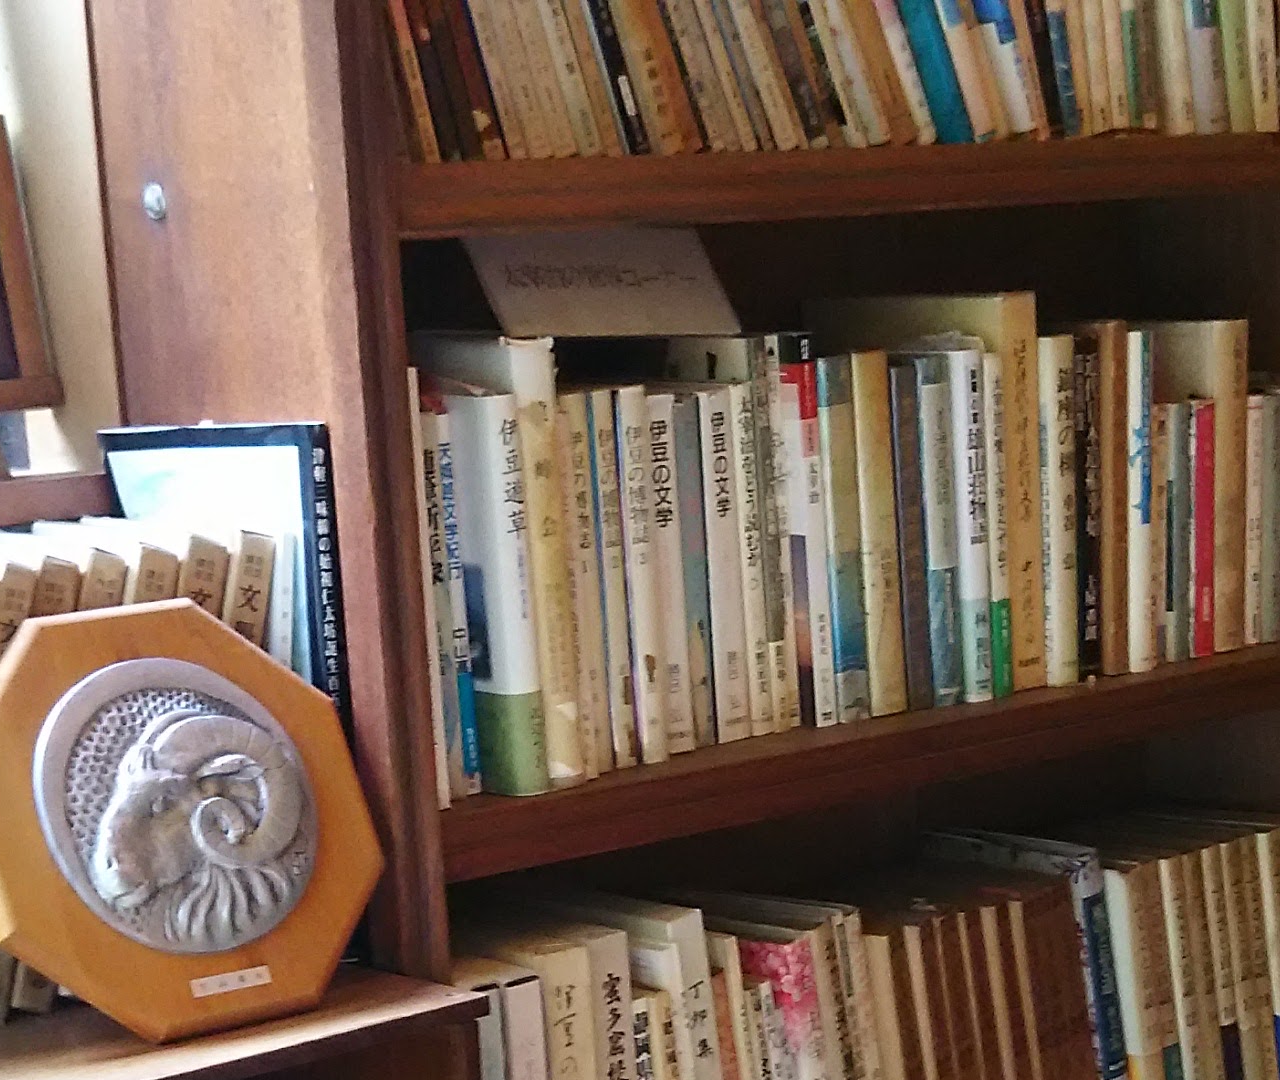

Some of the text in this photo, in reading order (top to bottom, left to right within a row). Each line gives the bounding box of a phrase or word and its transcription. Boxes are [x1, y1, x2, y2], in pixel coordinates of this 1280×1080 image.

[649, 420, 673, 528] 伊豆の文学
[710, 411, 733, 518] 伊豆の文学
